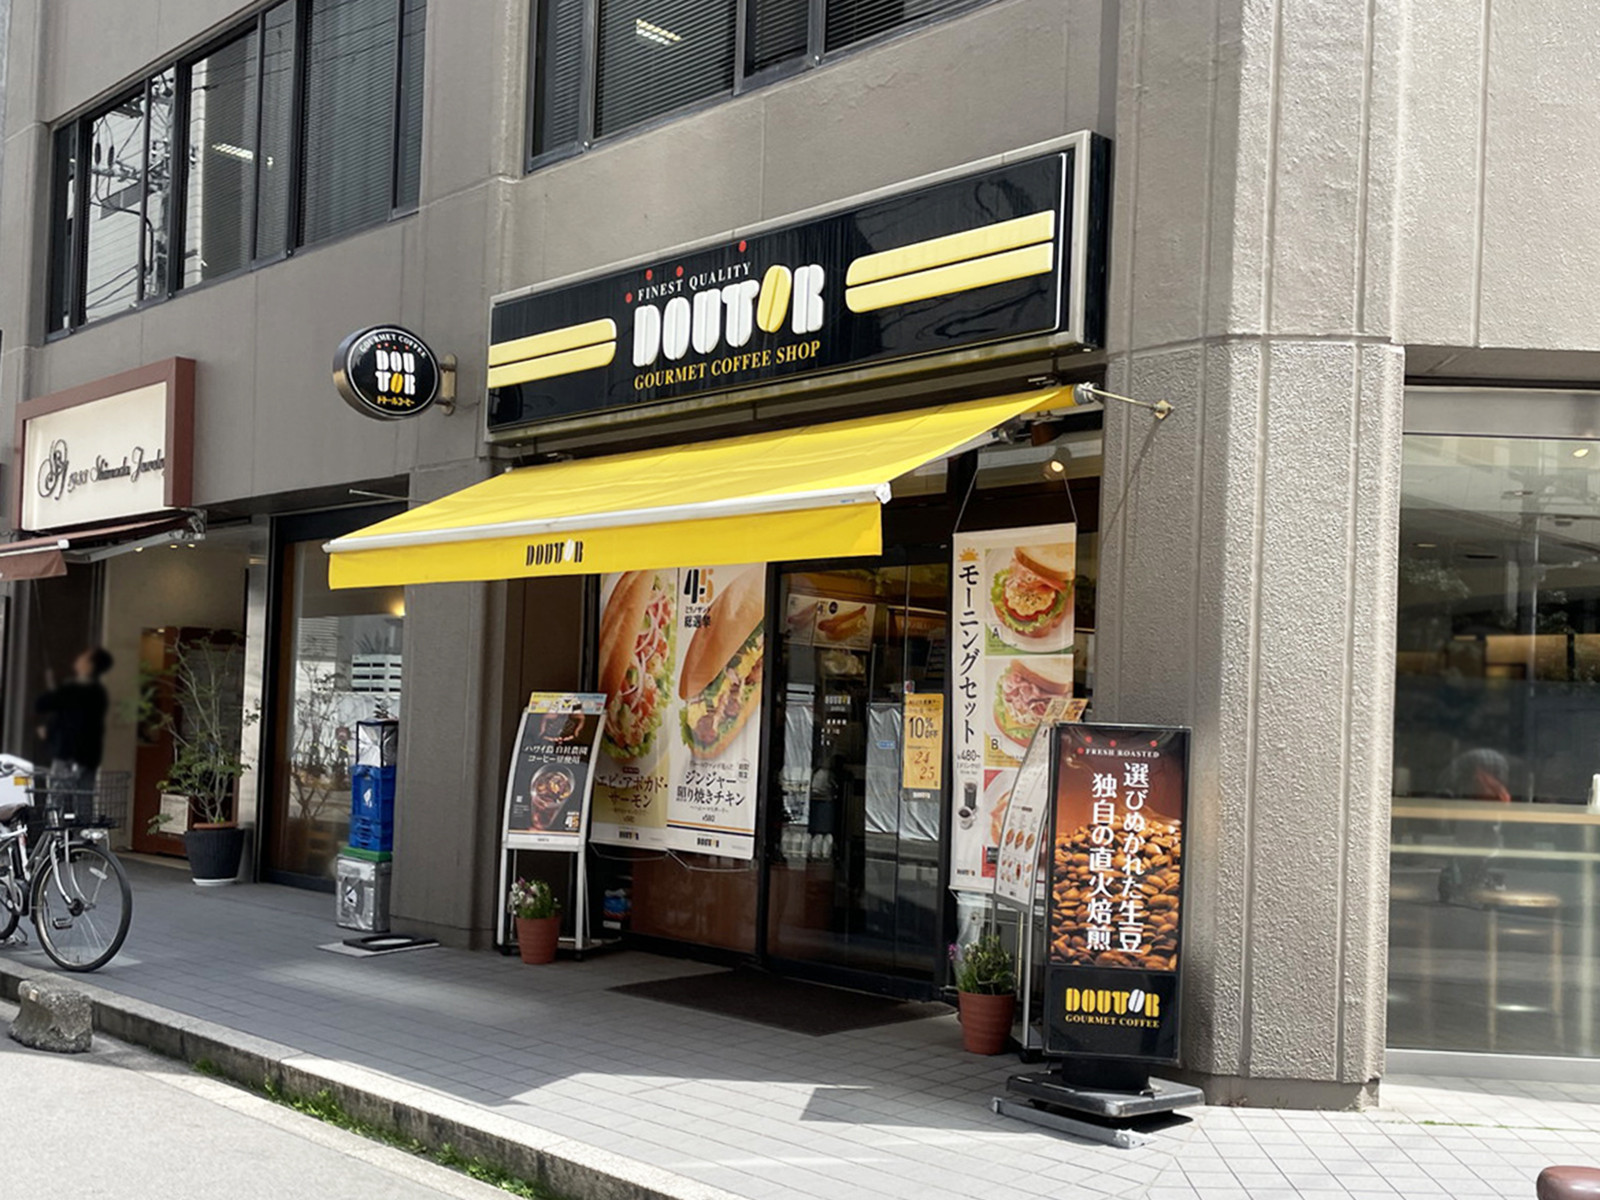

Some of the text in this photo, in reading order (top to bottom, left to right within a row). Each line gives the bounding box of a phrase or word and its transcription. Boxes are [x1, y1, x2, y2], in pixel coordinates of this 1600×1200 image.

[638, 262, 751, 301] FINEST QUALITY
[633, 264, 825, 367] DOUTOR
[634, 340, 821, 390] GOURMET COFFEE SHOP
[525, 539, 583, 566] DOUTOR
[992, 627, 1000, 639] A
[959, 565, 980, 744] モーニングセット
[991, 738, 999, 750] B
[1086, 748, 1160, 758] FRESH ROASTED
[686, 769, 737, 789] ジンジャー
[1086, 773, 1118, 950] 独自の直火焙煎
[1117, 762, 1150, 953] 選びぬかれた生豆
[1065, 987, 1160, 1018] DOUTOR
[1065, 1014, 1160, 1028] GOURMET COFFEE
